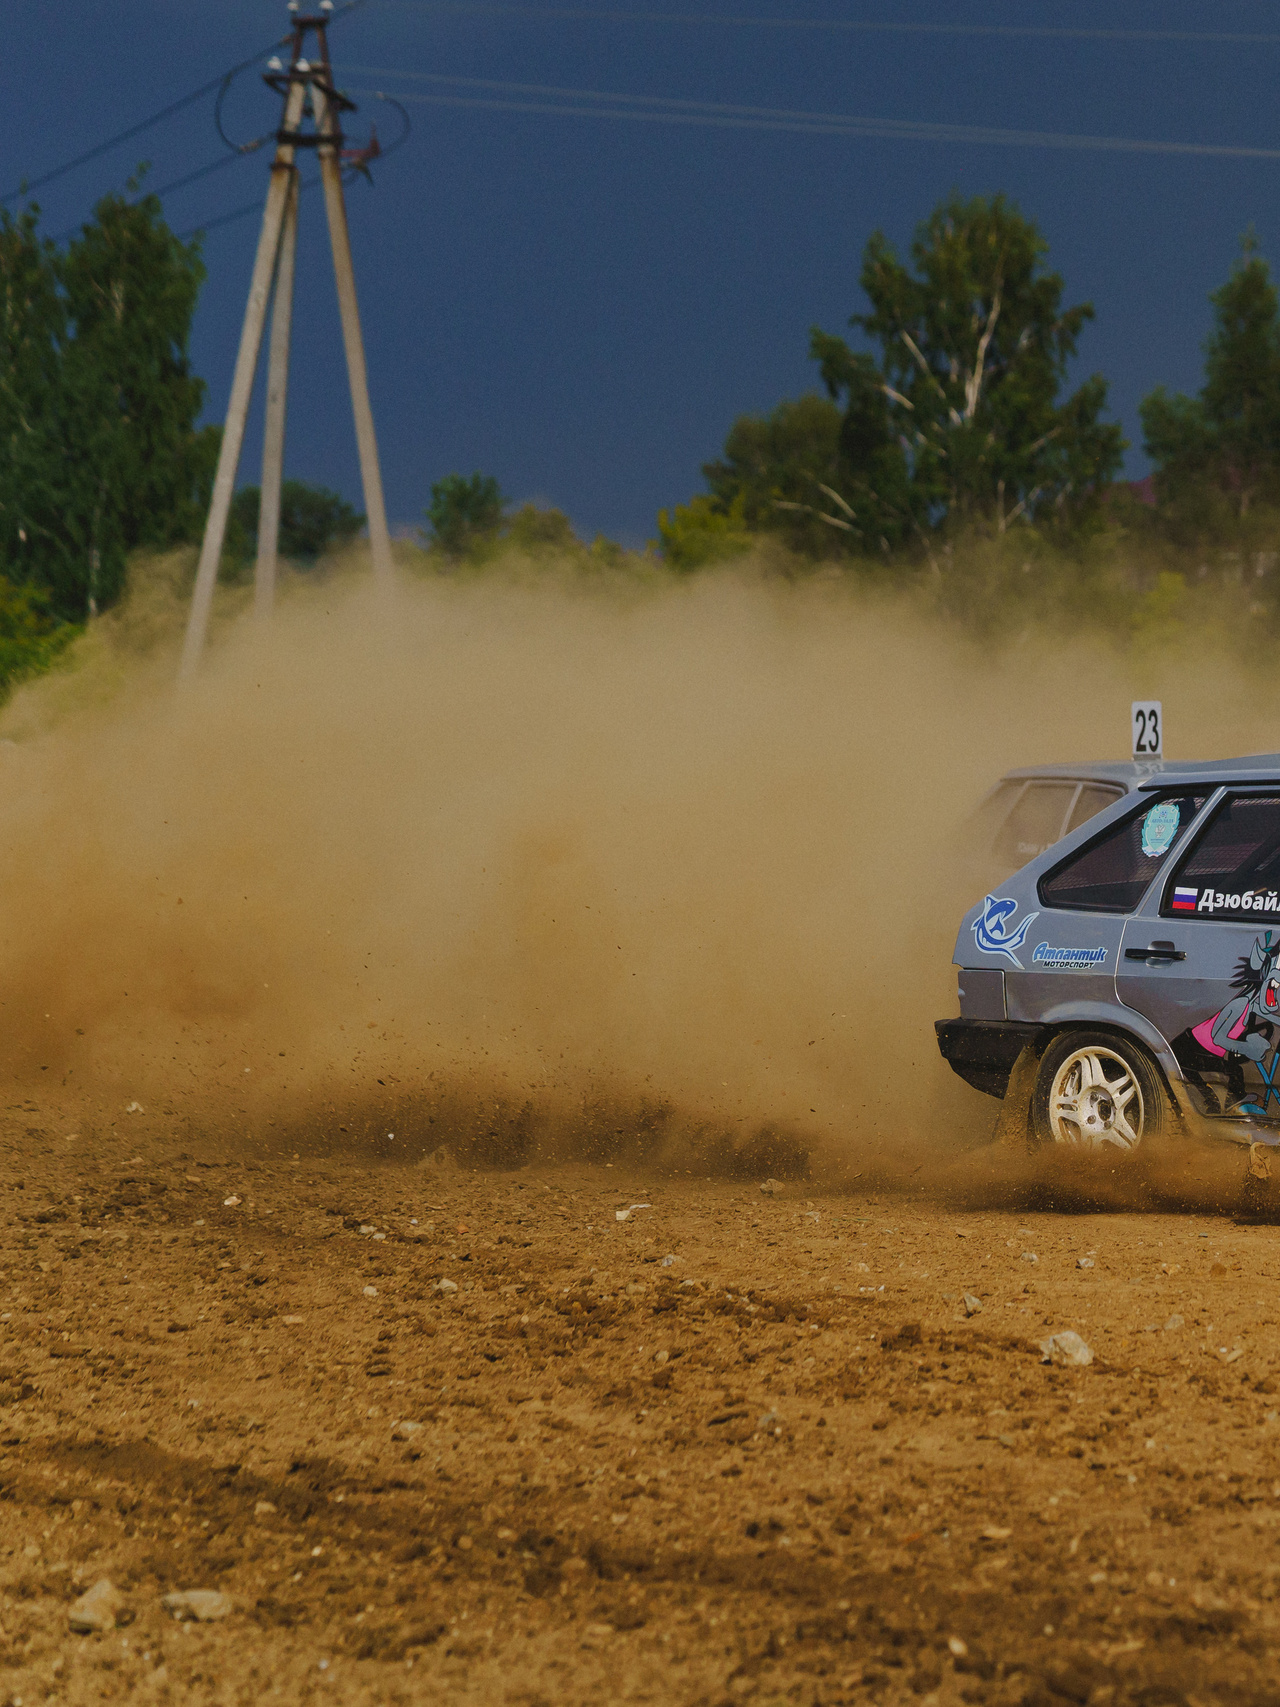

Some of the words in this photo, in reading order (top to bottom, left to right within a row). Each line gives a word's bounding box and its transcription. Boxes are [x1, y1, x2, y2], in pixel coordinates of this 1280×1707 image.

[1135, 709, 1159, 752] 23
[1033, 942, 1108, 962] Атлантик
[1043, 961, 1094, 969] МОТОРСПОРТ
